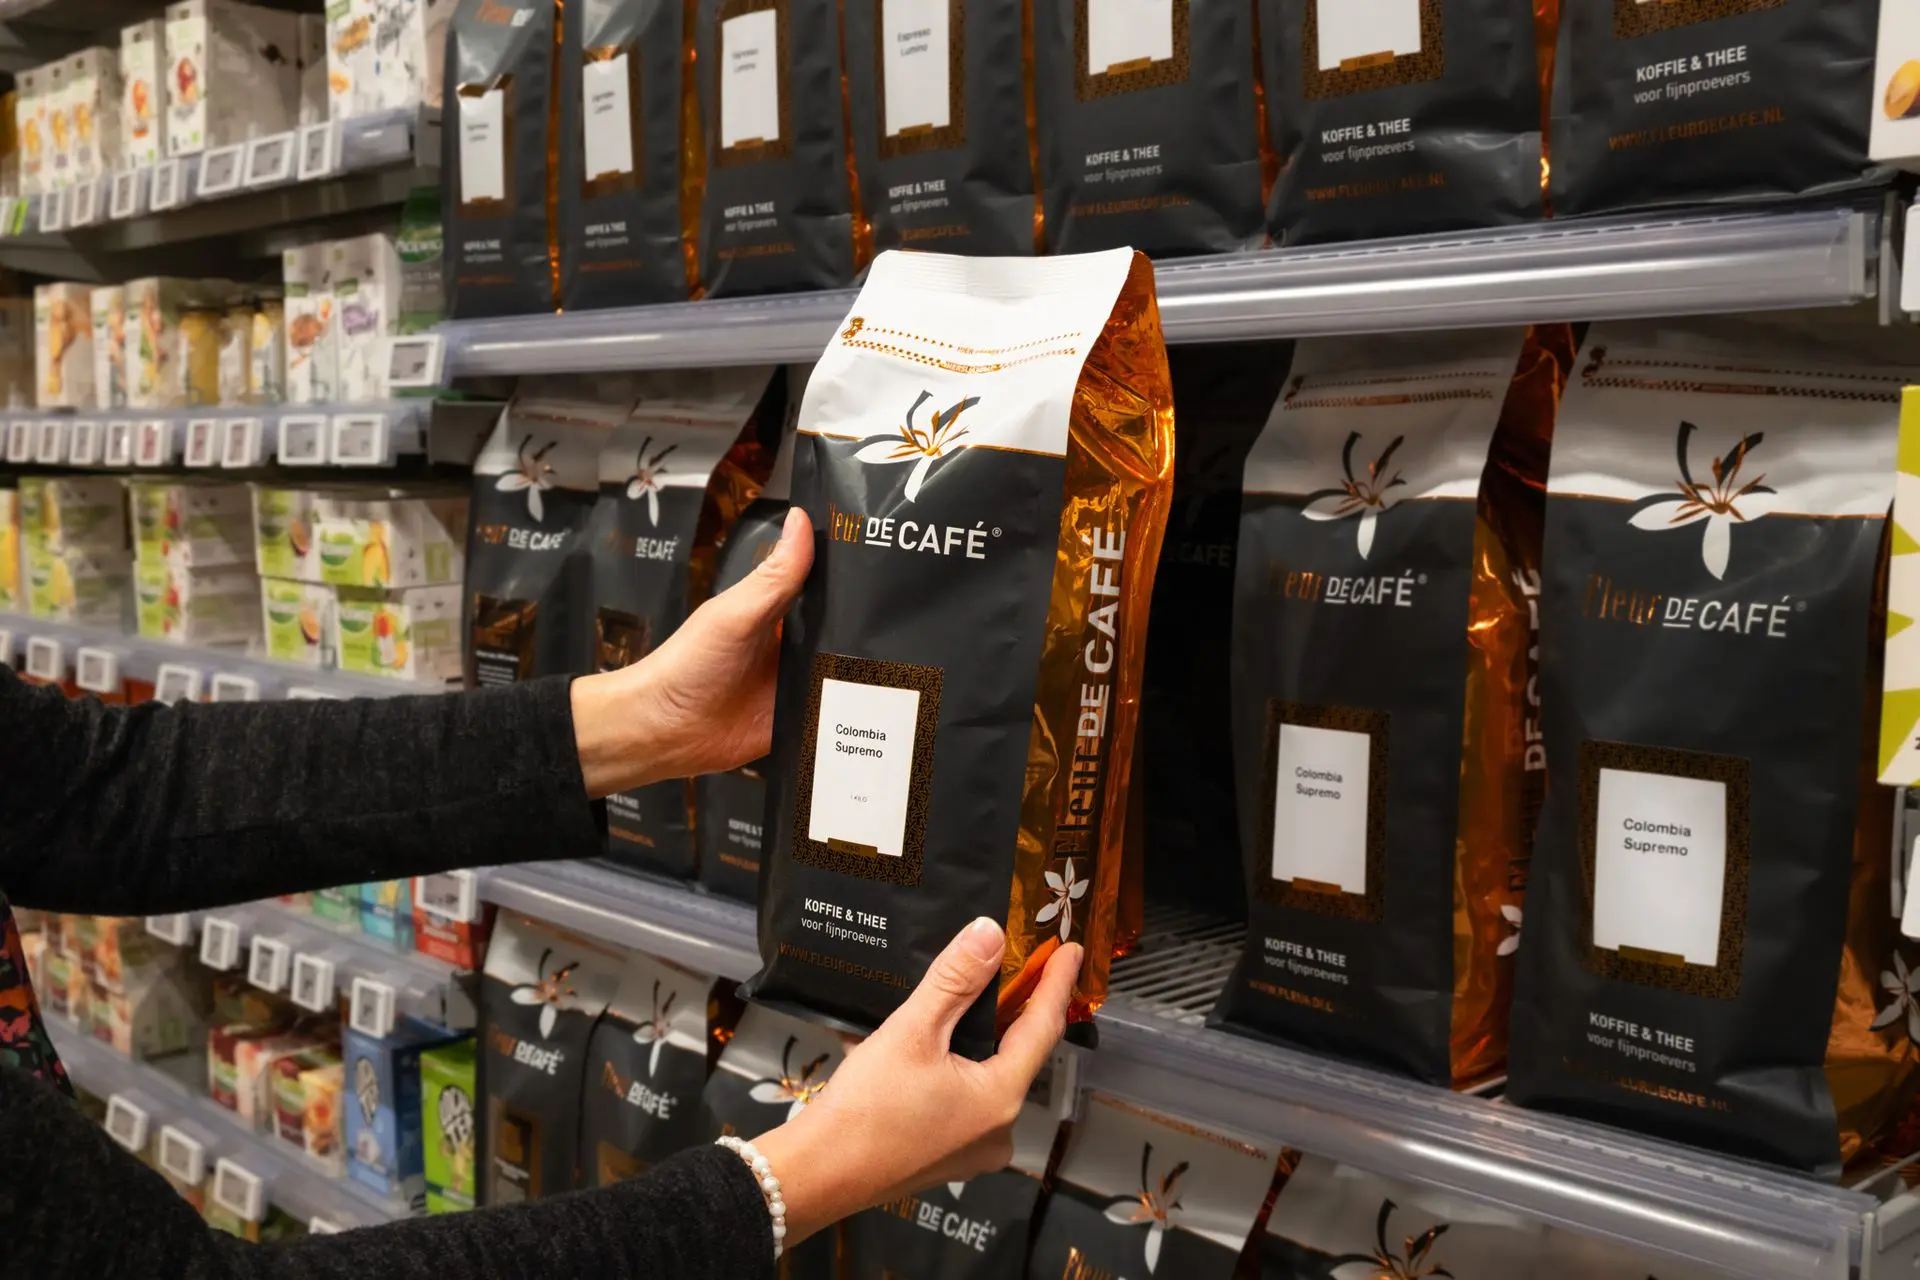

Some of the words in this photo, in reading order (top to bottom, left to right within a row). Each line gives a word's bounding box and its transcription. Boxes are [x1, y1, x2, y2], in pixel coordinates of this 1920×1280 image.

[1636, 58, 1687, 82] KOFFIE
[1690, 55, 1702, 71] &
[1705, 45, 1747, 68] THEE
[1633, 87, 1662, 104] voor
[1666, 70, 1752, 101] fijnproevers
[1322, 125, 1364, 144] KOFFIE
[1366, 123, 1376, 138] &
[1378, 118, 1411, 135] THEE
[1085, 150, 1121, 166] KOFFIE
[1122, 149, 1130, 162] &
[1133, 144, 1161, 160] THEE
[1321, 149, 1346, 163] voor
[1347, 140, 1416, 163] fijnproevers
[889, 183, 914, 198] KOFFIE
[923, 179, 946, 192] THEE
[508, 527, 530, 549] DE
[865, 517, 896, 548] DE
[898, 521, 988, 560] CAFÉ
[1082, 526, 1126, 674] CAFÉ
[1324, 576, 1352, 604] DE
[1350, 568, 1415, 607] CAFÉ
[1662, 597, 1699, 628] DE
[1698, 595, 1791, 638] CAFÉ
[1077, 683, 1110, 738] DE
[835, 723, 887, 741] Colombia
[835, 741, 883, 758] Supremo
[1295, 766, 1343, 783] Colombia
[1296, 782, 1341, 800] Supremo
[1623, 817, 1692, 837] Colombia
[1624, 837, 1689, 857] Supremo
[804, 898, 843, 919] KOFFIE
[845, 909, 854, 922] &
[856, 911, 887, 930] THEE
[801, 917, 823, 931] voor
[825, 922, 888, 949] fijnproevers
[779, 942, 911, 990] WWW.FLEURDECAFE.NL
[1263, 954, 1285, 968] voor
[1264, 937, 1304, 957] KOFFIE
[1305, 947, 1314, 960] &
[1316, 949, 1347, 968] THEE
[1589, 1011, 1639, 1038] KOFFIE
[1641, 1026, 1652, 1041] &
[1655, 1029, 1694, 1053] THEE
[1587, 1032, 1615, 1049] voor
[1617, 1038, 1696, 1073] fijnproevers
[916, 1202, 943, 1232] DE
[942, 1212, 991, 1253] CAFÉ
